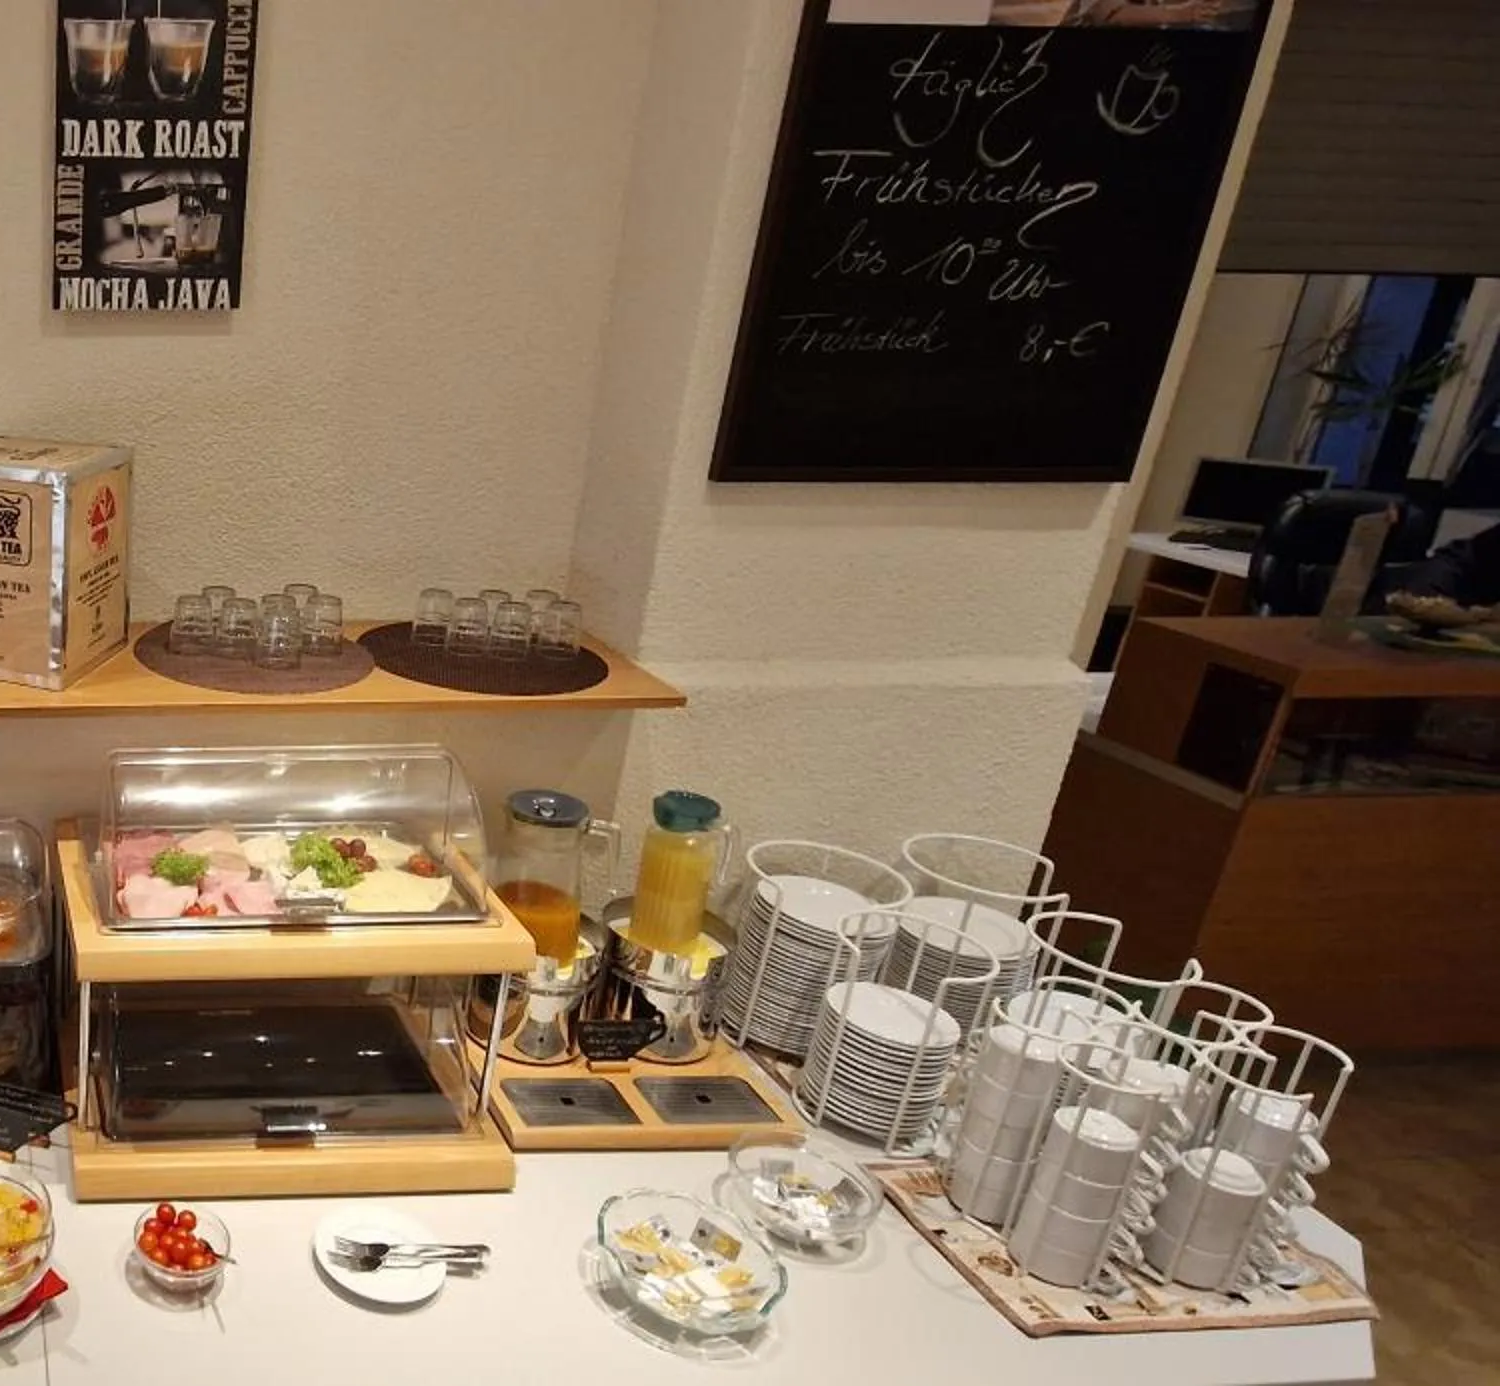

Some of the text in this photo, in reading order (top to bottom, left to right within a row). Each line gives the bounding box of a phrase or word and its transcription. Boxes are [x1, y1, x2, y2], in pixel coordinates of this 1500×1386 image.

[62, 119, 245, 159] DARK ROAST
[56, 163, 84, 271] GRANDE
[812, 218, 887, 279] bis
[989, 258, 1071, 301] Uhr
[59, 277, 232, 311] MOCHA JAVA
[778, 309, 949, 354] Frühstück
[1, 540, 23, 555] TEA
[11, 581, 31, 593] TEA
